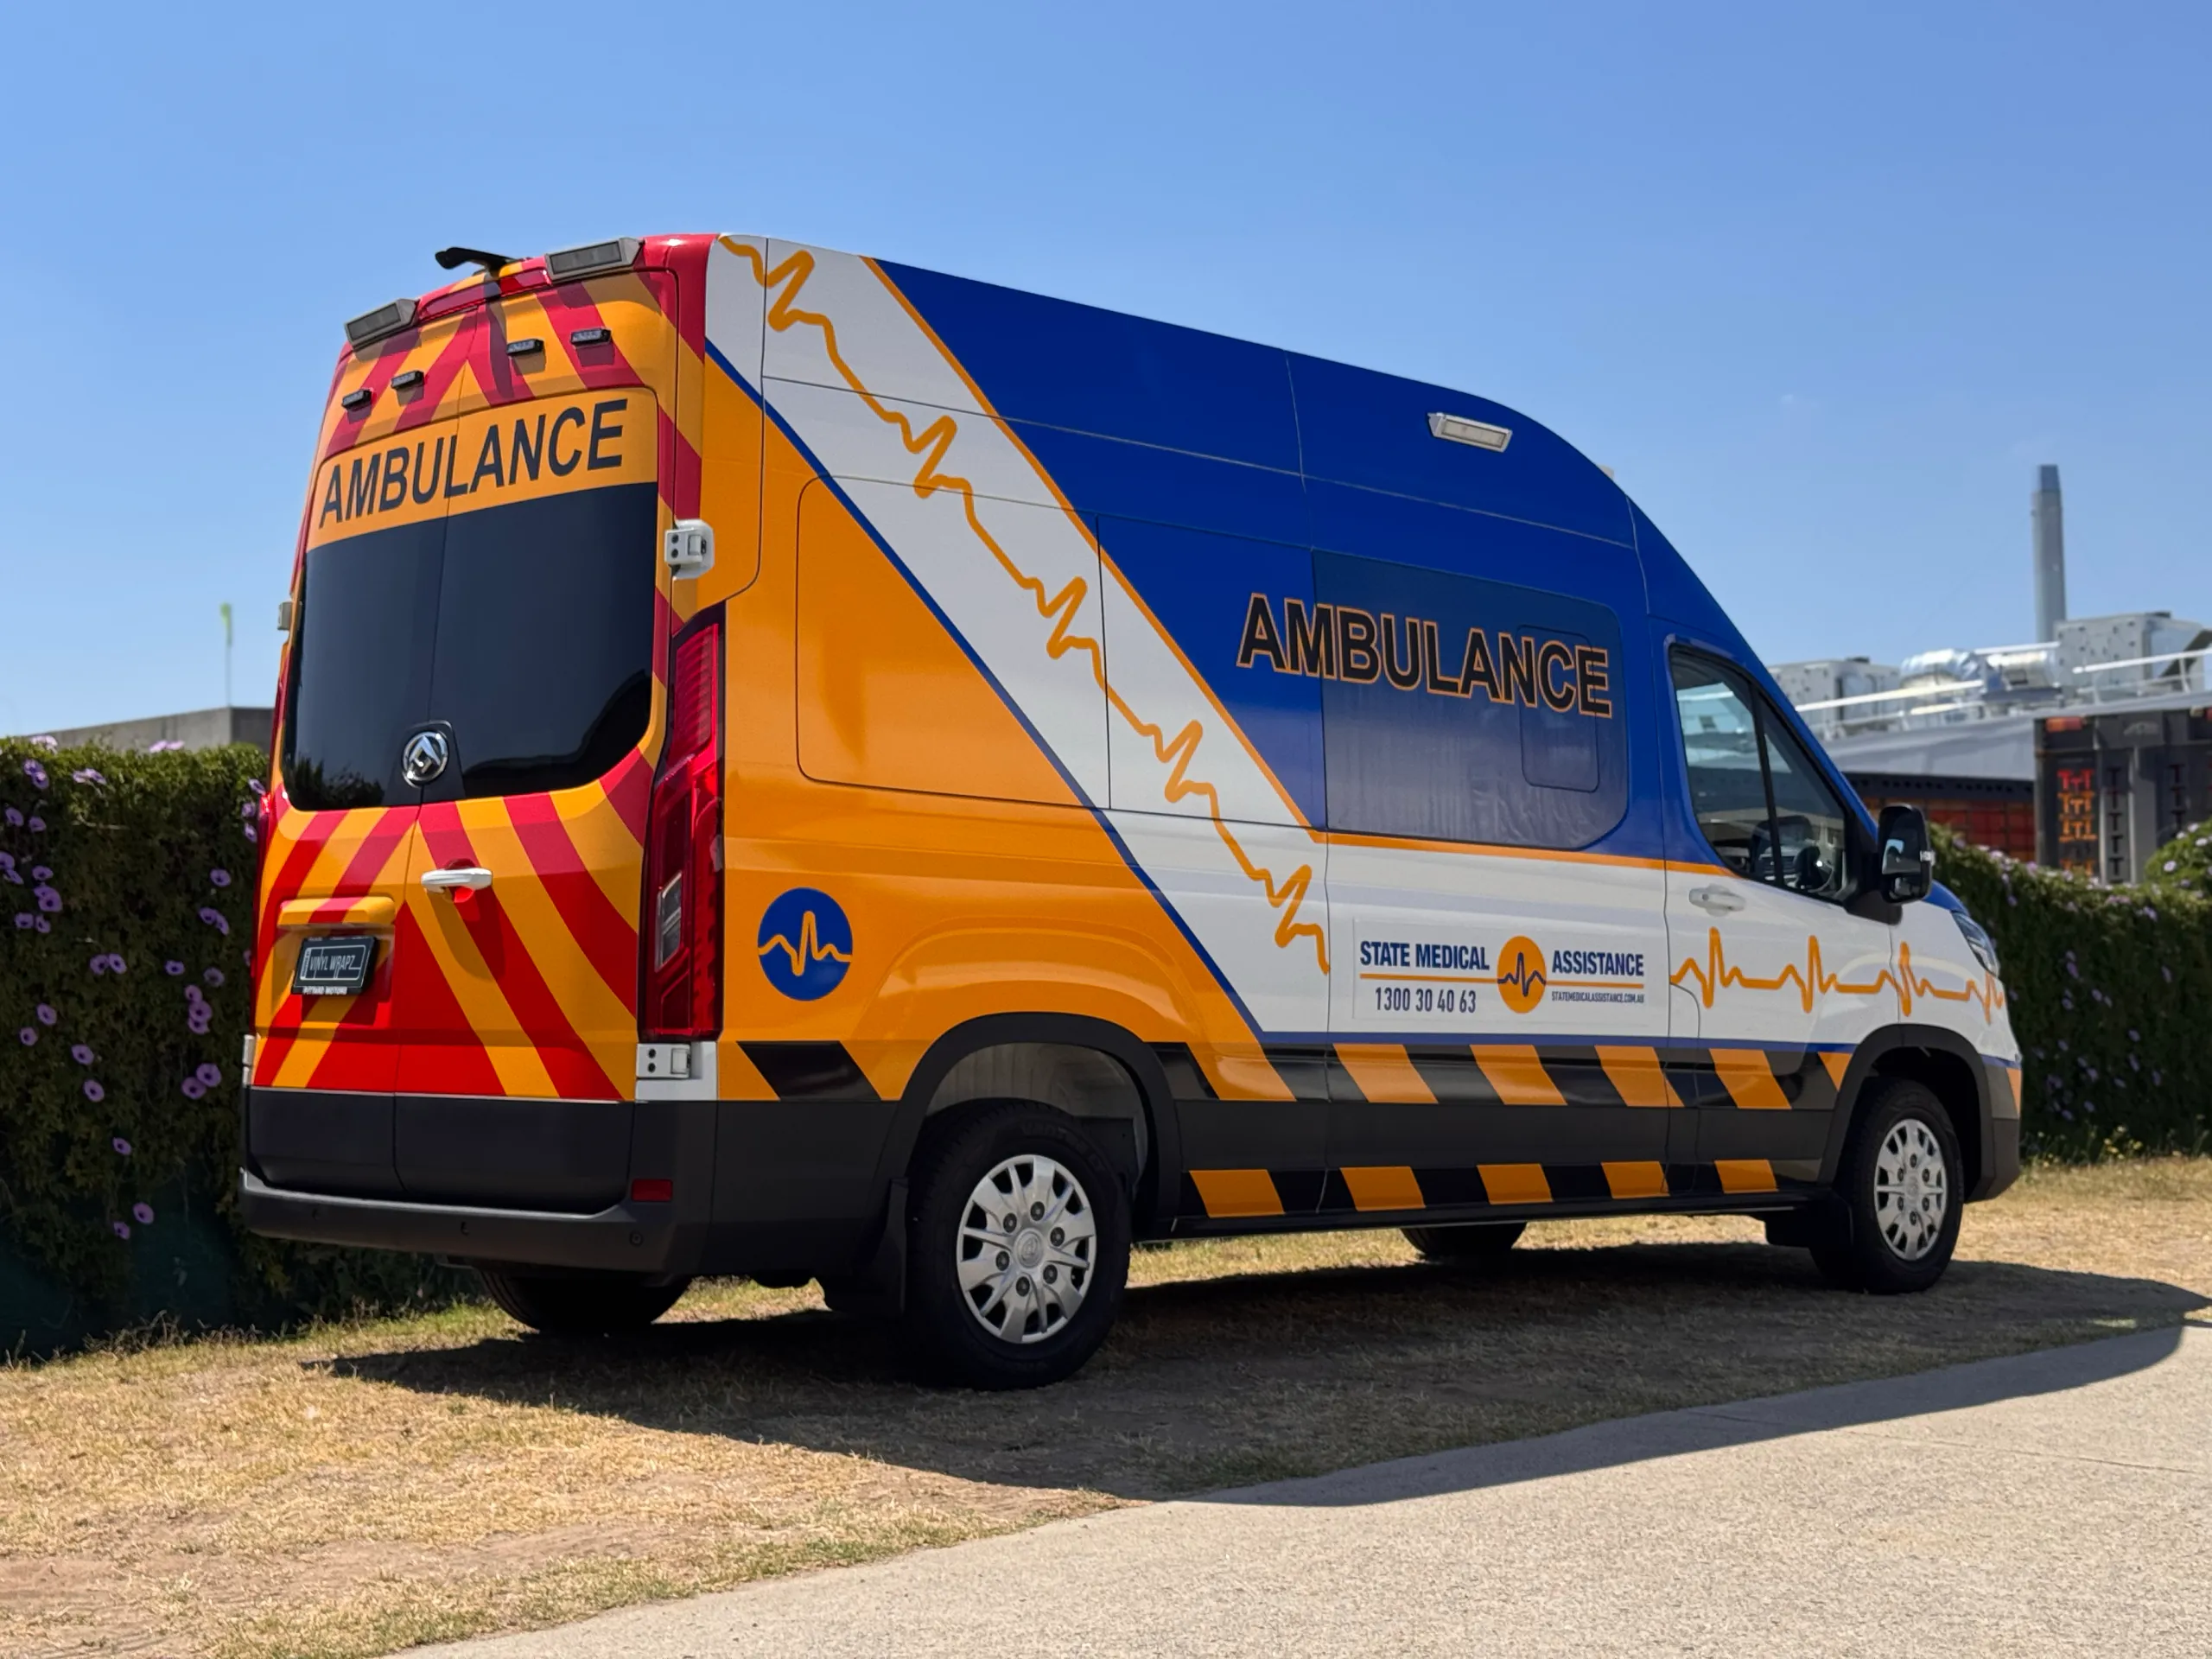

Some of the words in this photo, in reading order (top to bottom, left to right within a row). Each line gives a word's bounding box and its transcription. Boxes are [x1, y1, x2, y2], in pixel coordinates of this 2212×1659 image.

[319, 398, 628, 529] AMBULANCE
[1236, 592, 1612, 719] AMBULANCE
[309, 955, 329, 971] VINYL
[329, 954, 356, 971] WRAPZ
[1360, 940, 1410, 968] STATE
[1415, 943, 1490, 971] MEDICAL
[1552, 950, 1644, 976] ASSISTANCE
[1376, 987, 1411, 1012] 1300
[1415, 988, 1433, 1013] 30
[1437, 989, 1455, 1013] 40
[1459, 990, 1477, 1014] 63
